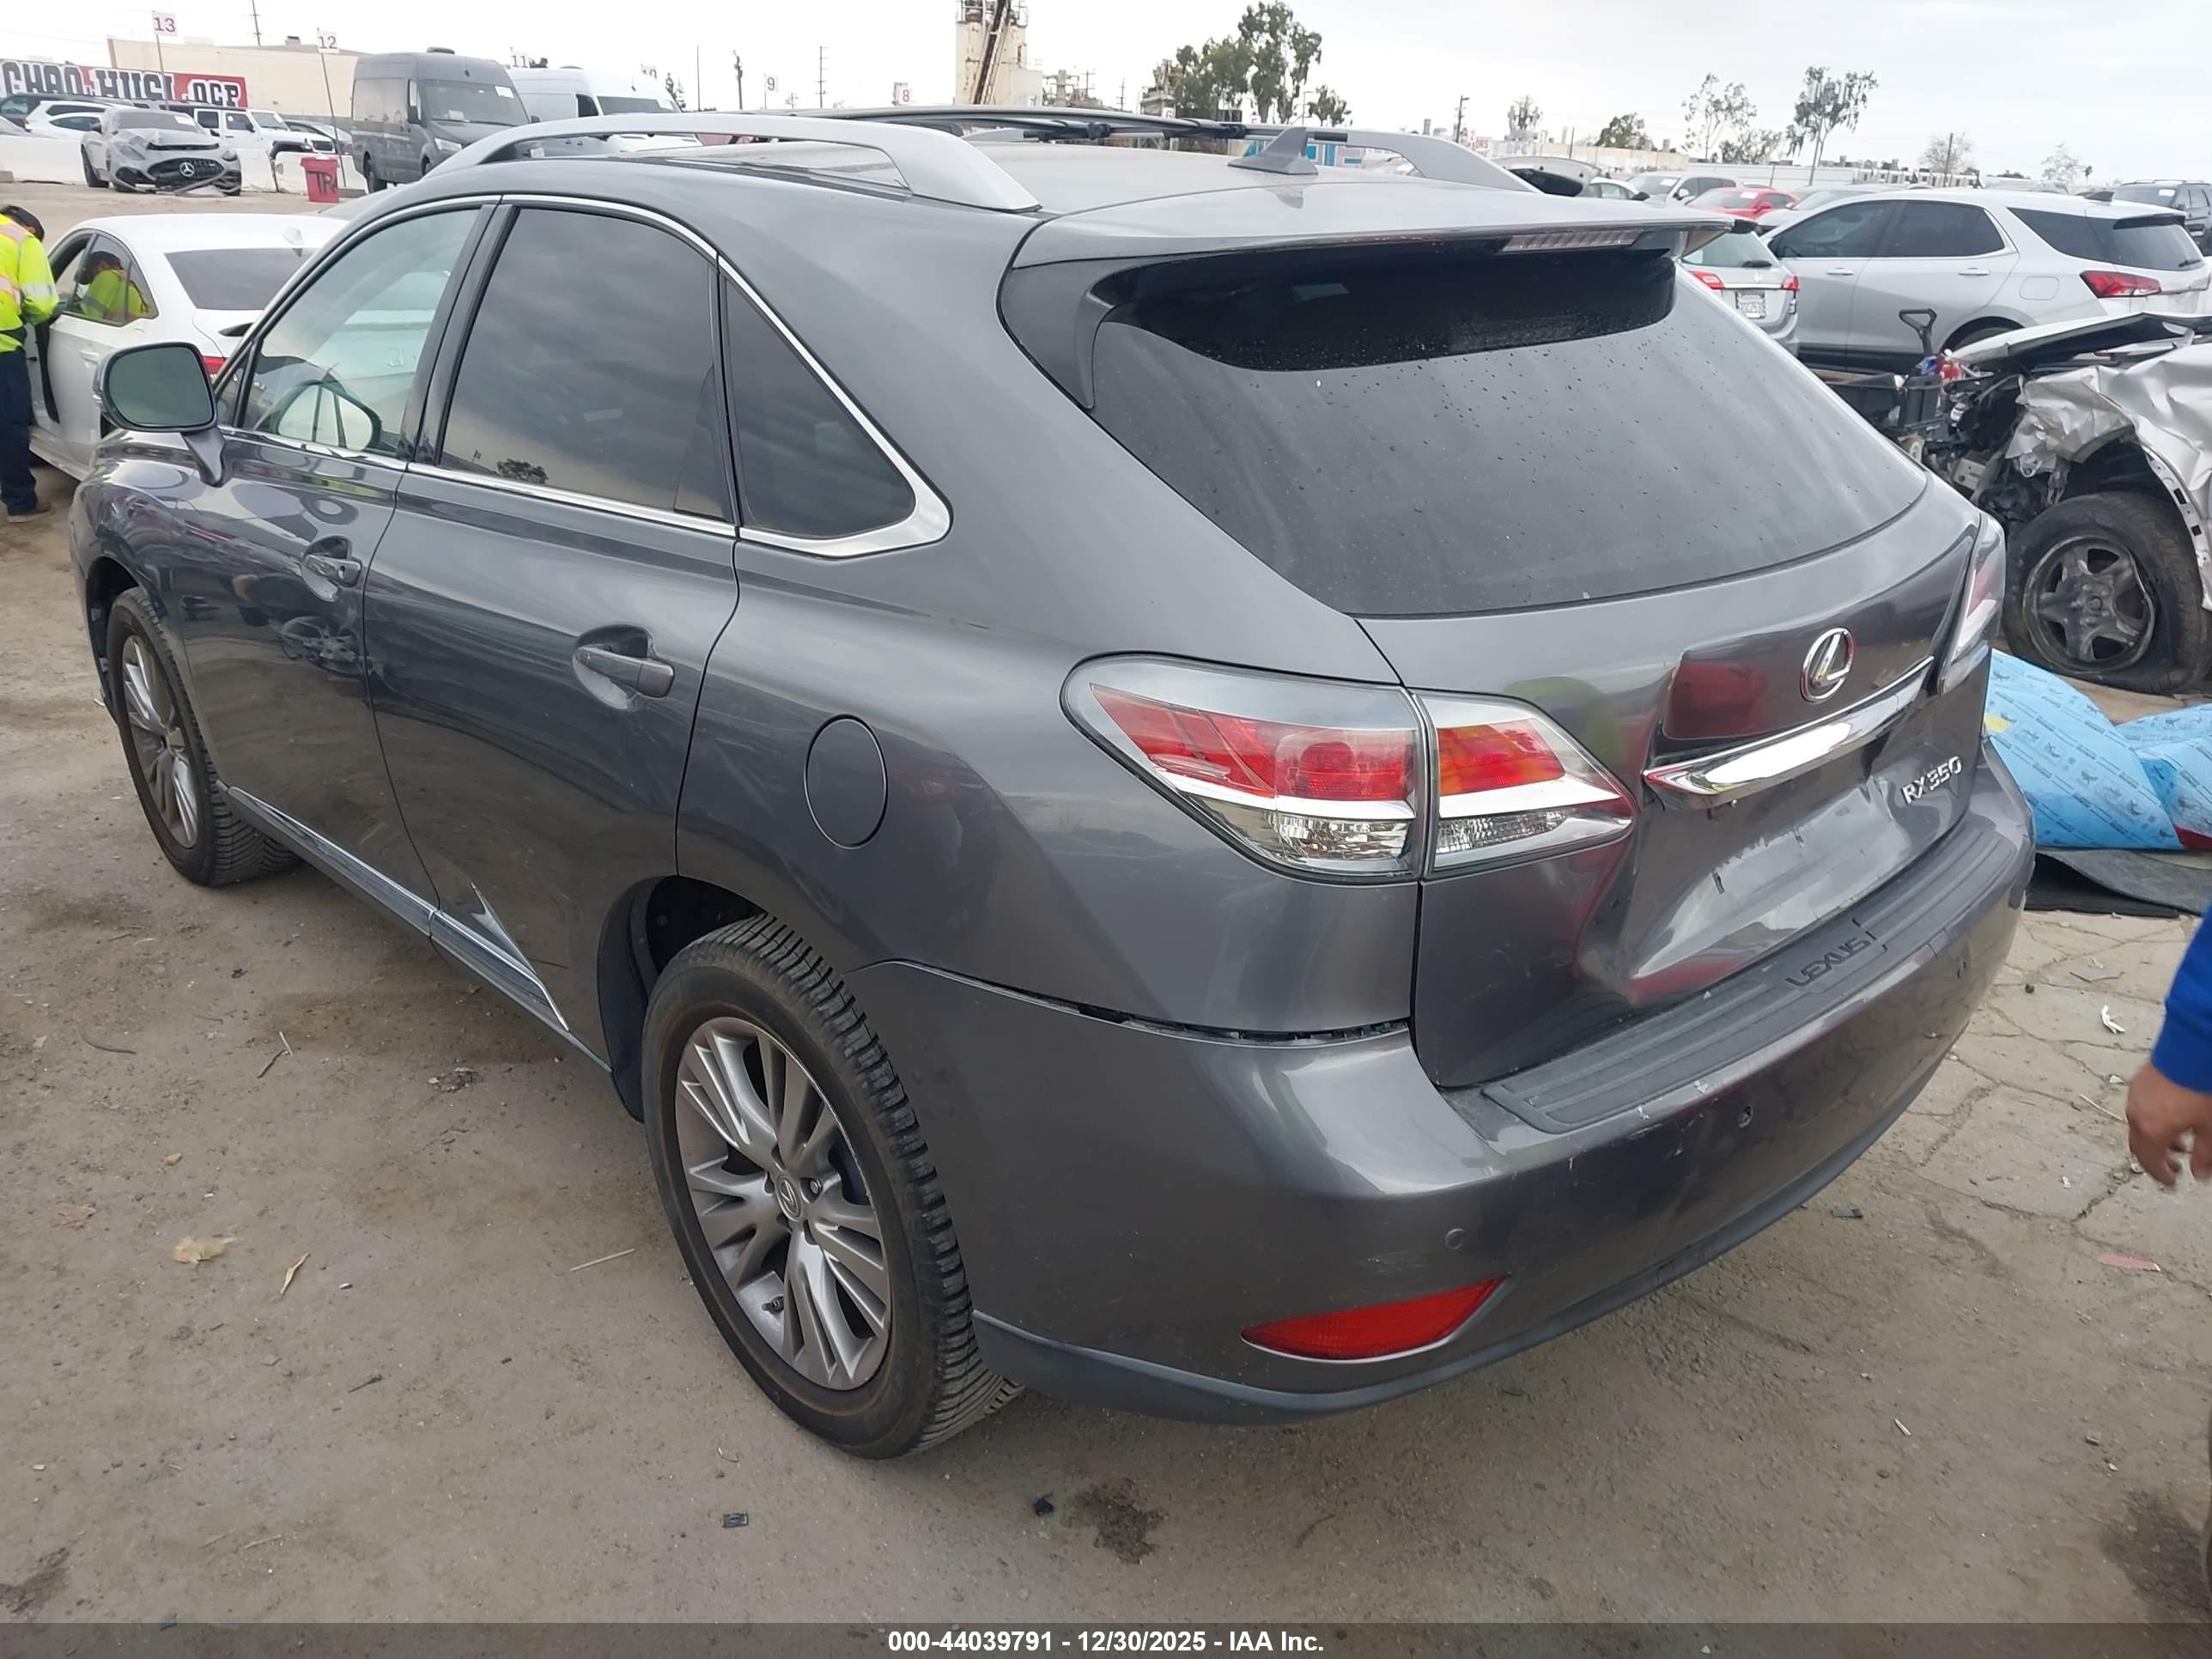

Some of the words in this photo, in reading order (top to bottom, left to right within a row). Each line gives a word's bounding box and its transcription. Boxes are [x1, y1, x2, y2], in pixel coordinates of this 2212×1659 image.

[154, 17, 175, 33] 13
[318, 35, 337, 49] 12
[512, 55, 528, 68] 11
[767, 76, 775, 91] 9
[902, 88, 910, 102] 8
[1785, 936, 1871, 987] LEXUS
